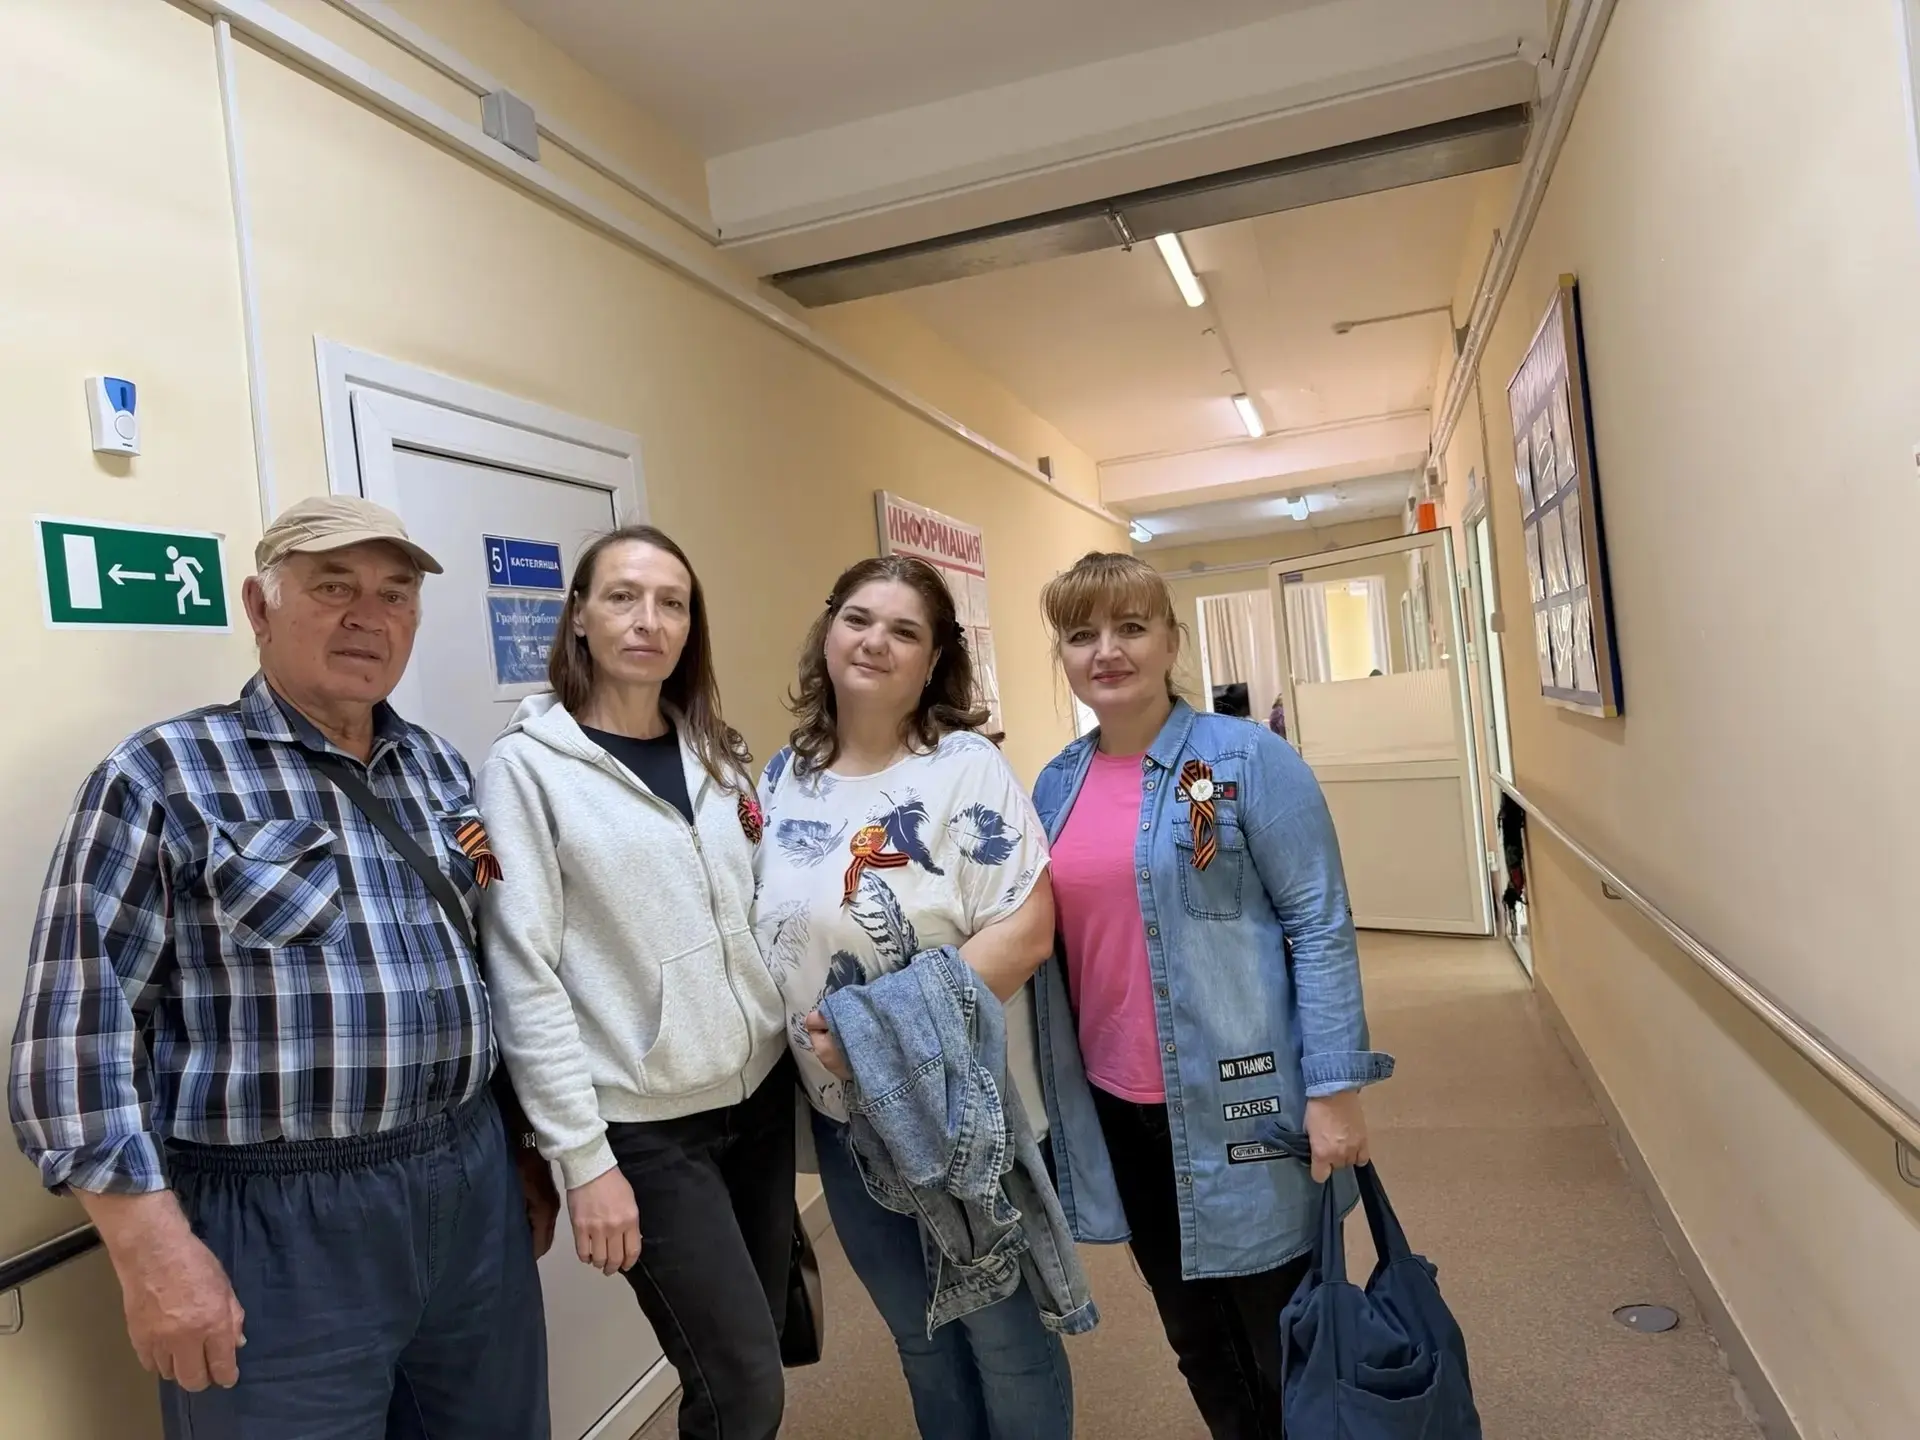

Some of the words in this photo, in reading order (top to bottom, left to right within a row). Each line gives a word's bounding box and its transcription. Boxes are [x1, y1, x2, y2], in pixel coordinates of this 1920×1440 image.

[888, 505, 982, 565] ИНФОРМАЦИЯ
[492, 547, 503, 573] 5
[510, 557, 560, 571] КАСТЕЛЯНША
[495, 611, 530, 626] График
[1221, 1062, 1236, 1079] NO
[1237, 1056, 1273, 1077] THANKS
[1231, 1101, 1273, 1118] PARIS
